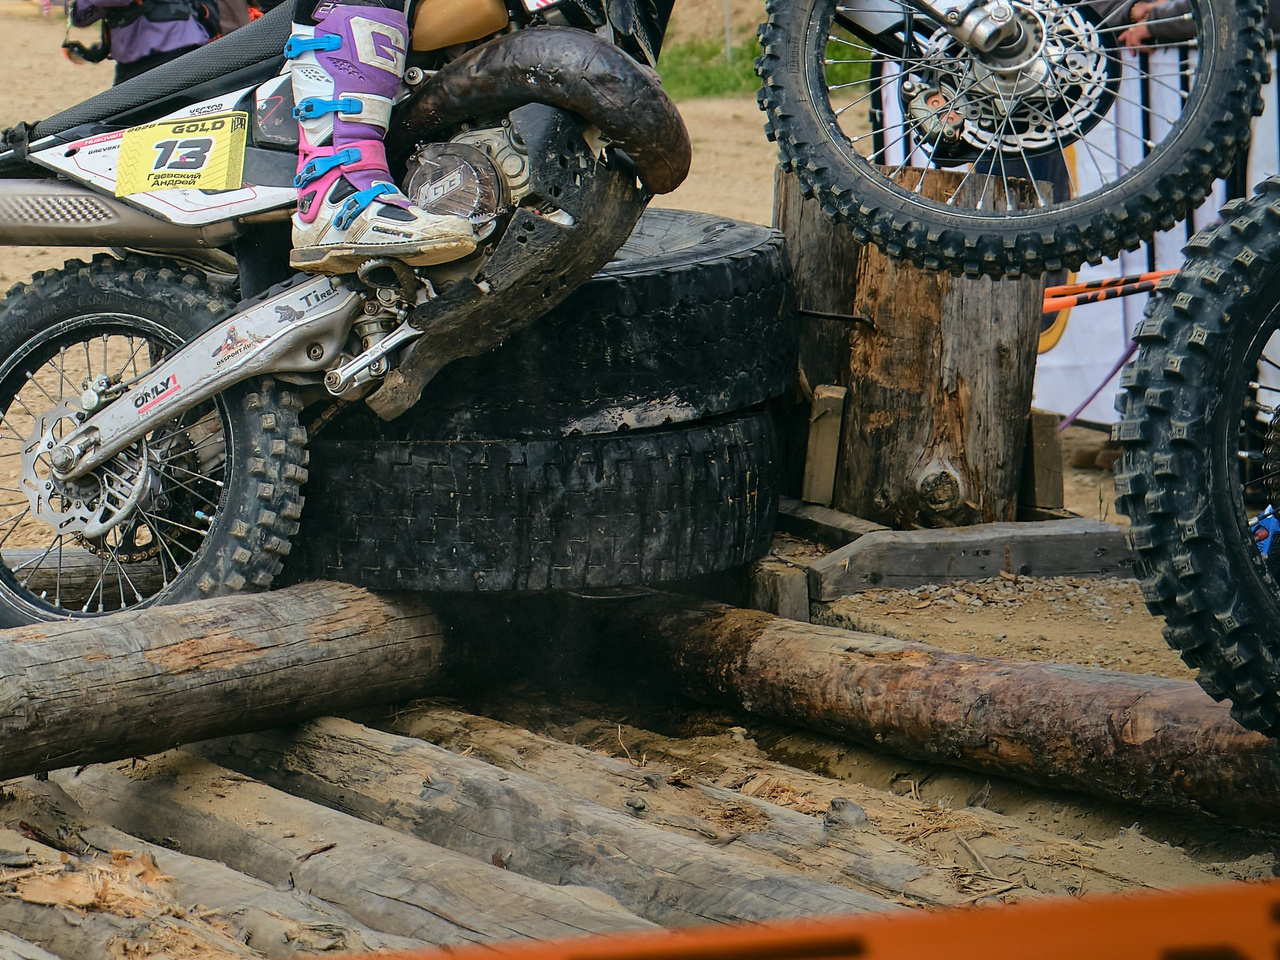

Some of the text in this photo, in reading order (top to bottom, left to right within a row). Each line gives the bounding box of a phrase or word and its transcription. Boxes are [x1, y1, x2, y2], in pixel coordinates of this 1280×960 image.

[127, 123, 156, 133] 2026
[171, 120, 226, 134] GOLD
[153, 138, 213, 170] 13
[147, 172, 202, 181] Гаевский
[151, 178, 196, 187] Андрей
[216, 342, 253, 366] OSSPORT.RU
[134, 373, 177, 408] ONLY1
